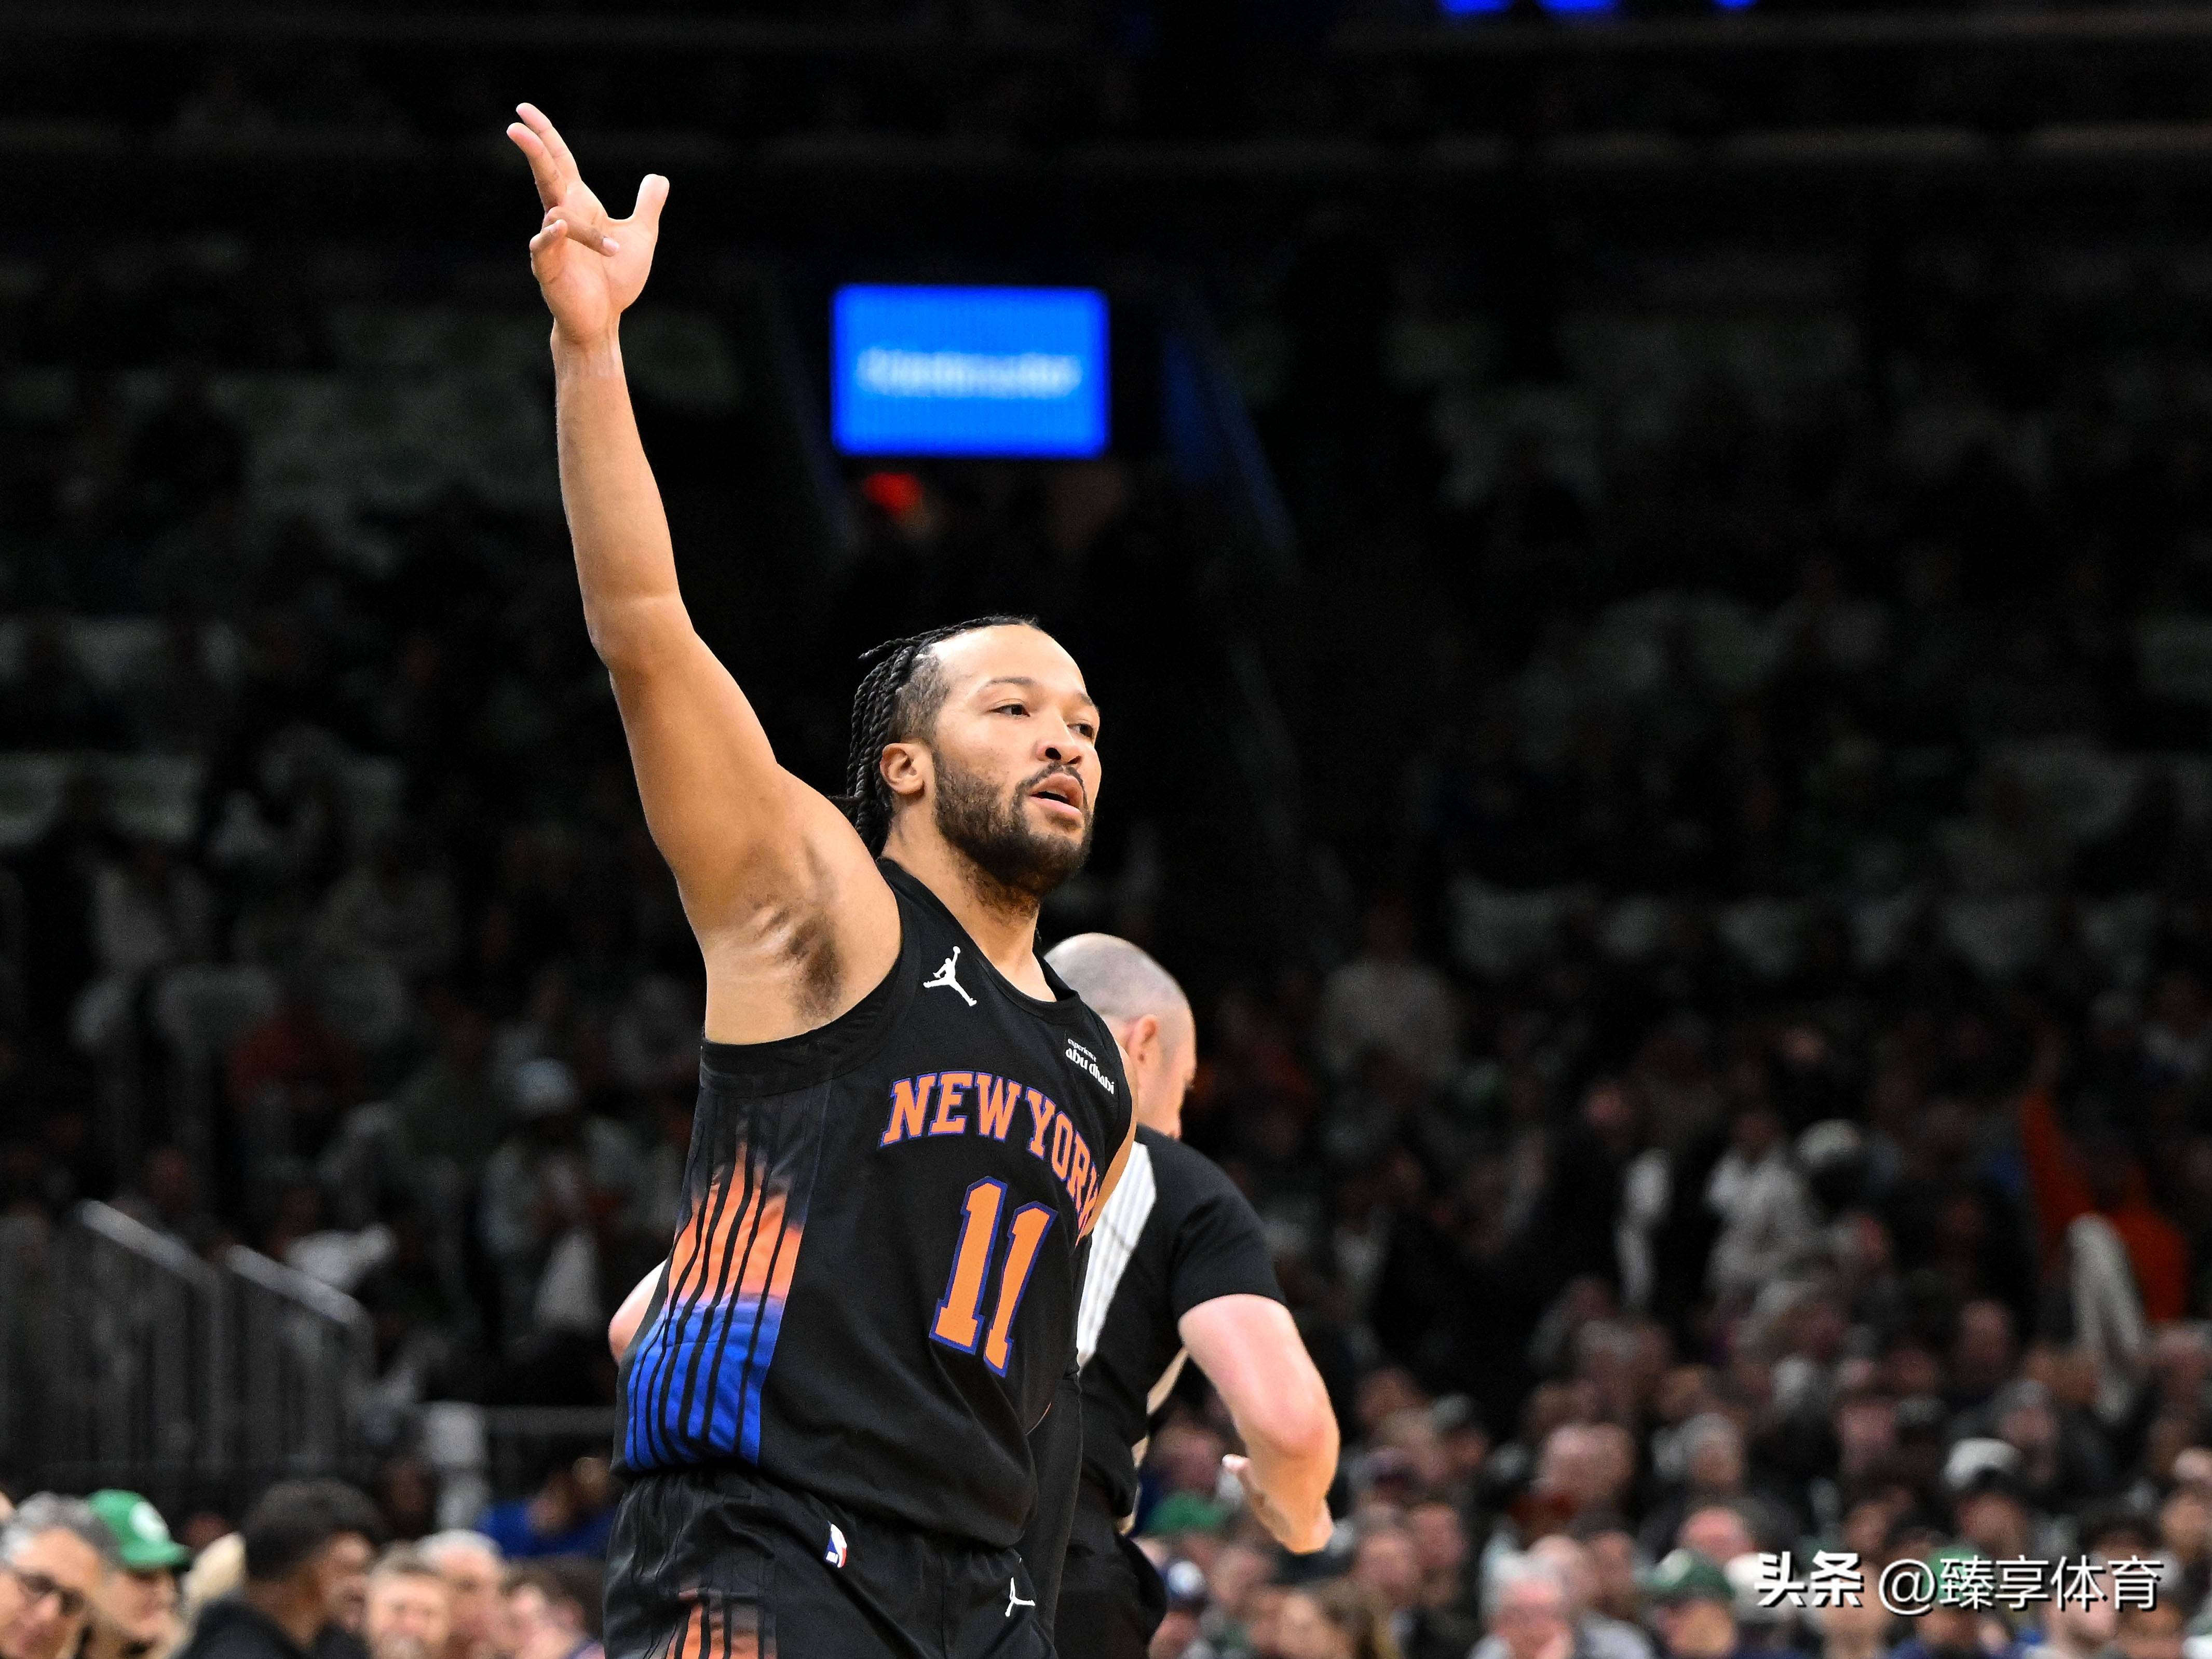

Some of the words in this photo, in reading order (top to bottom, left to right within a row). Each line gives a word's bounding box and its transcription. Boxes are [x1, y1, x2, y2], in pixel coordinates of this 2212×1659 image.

[1065, 1048, 1088, 1070] abu
[1089, 1063, 1115, 1095] dhabi
[1067, 1038, 1096, 1062] experience
[879, 1070, 1022, 1148] NEW
[928, 1175, 1058, 1378] 11
